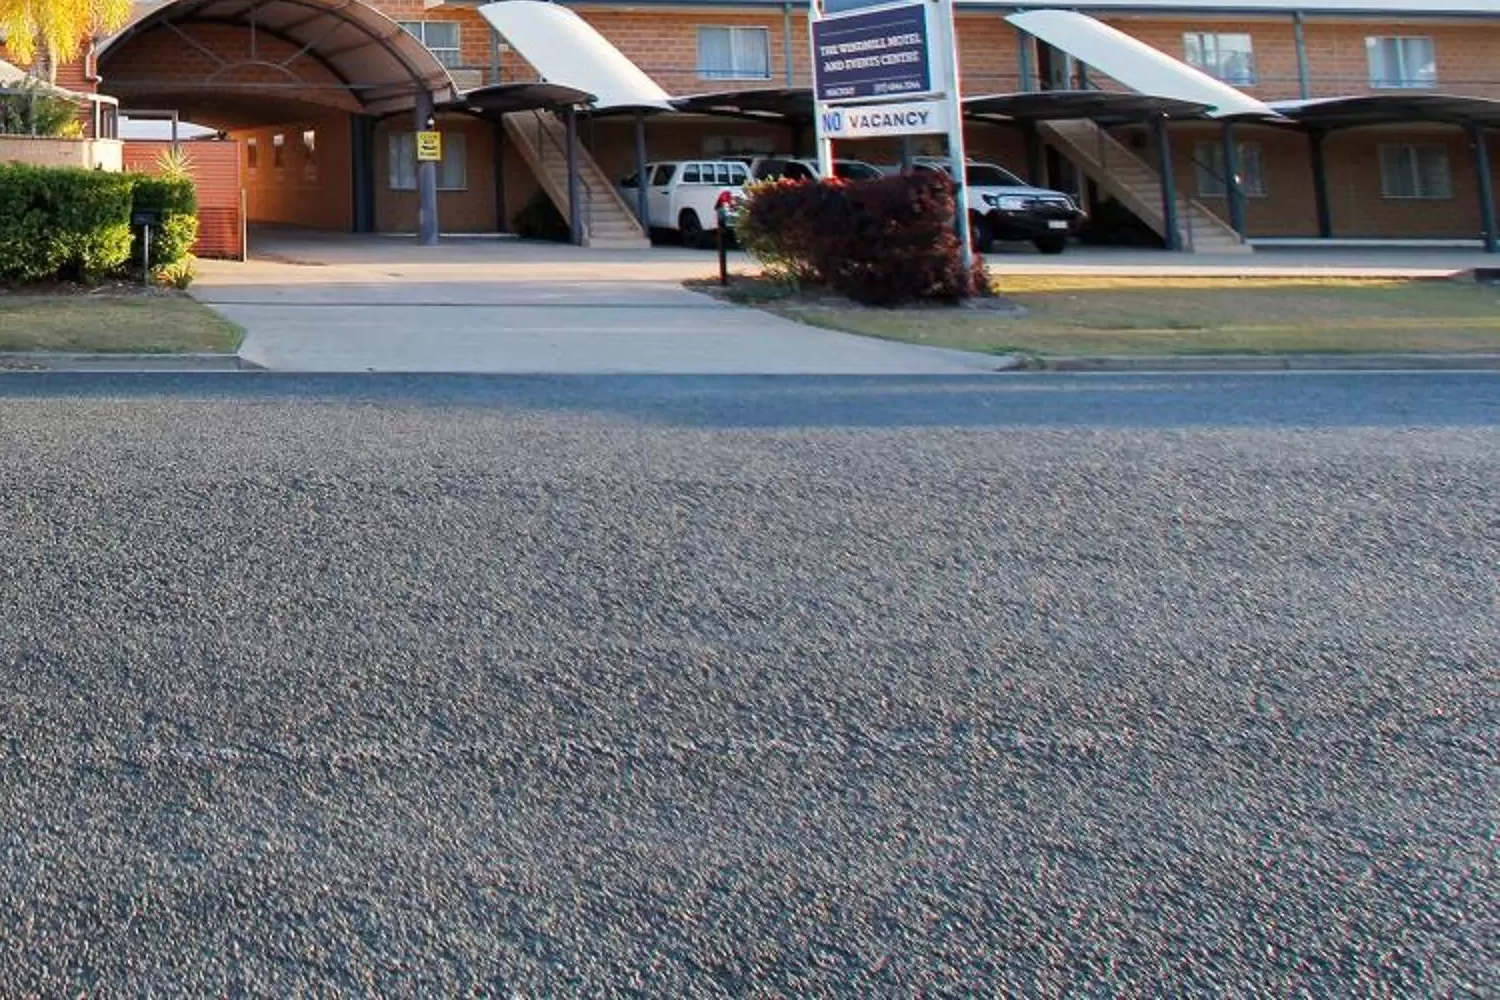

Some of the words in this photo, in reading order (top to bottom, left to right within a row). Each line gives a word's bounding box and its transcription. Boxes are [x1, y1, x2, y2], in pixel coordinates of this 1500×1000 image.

[821, 46, 839, 56] THE
[839, 38, 887, 53] WINDMILL
[887, 33, 921, 46] MOTEL
[824, 61, 844, 72] AND
[845, 56, 880, 69] EVENTS
[881, 51, 918, 64] CENTRE
[822, 112, 841, 132] NO
[849, 112, 928, 128] VACANCY
